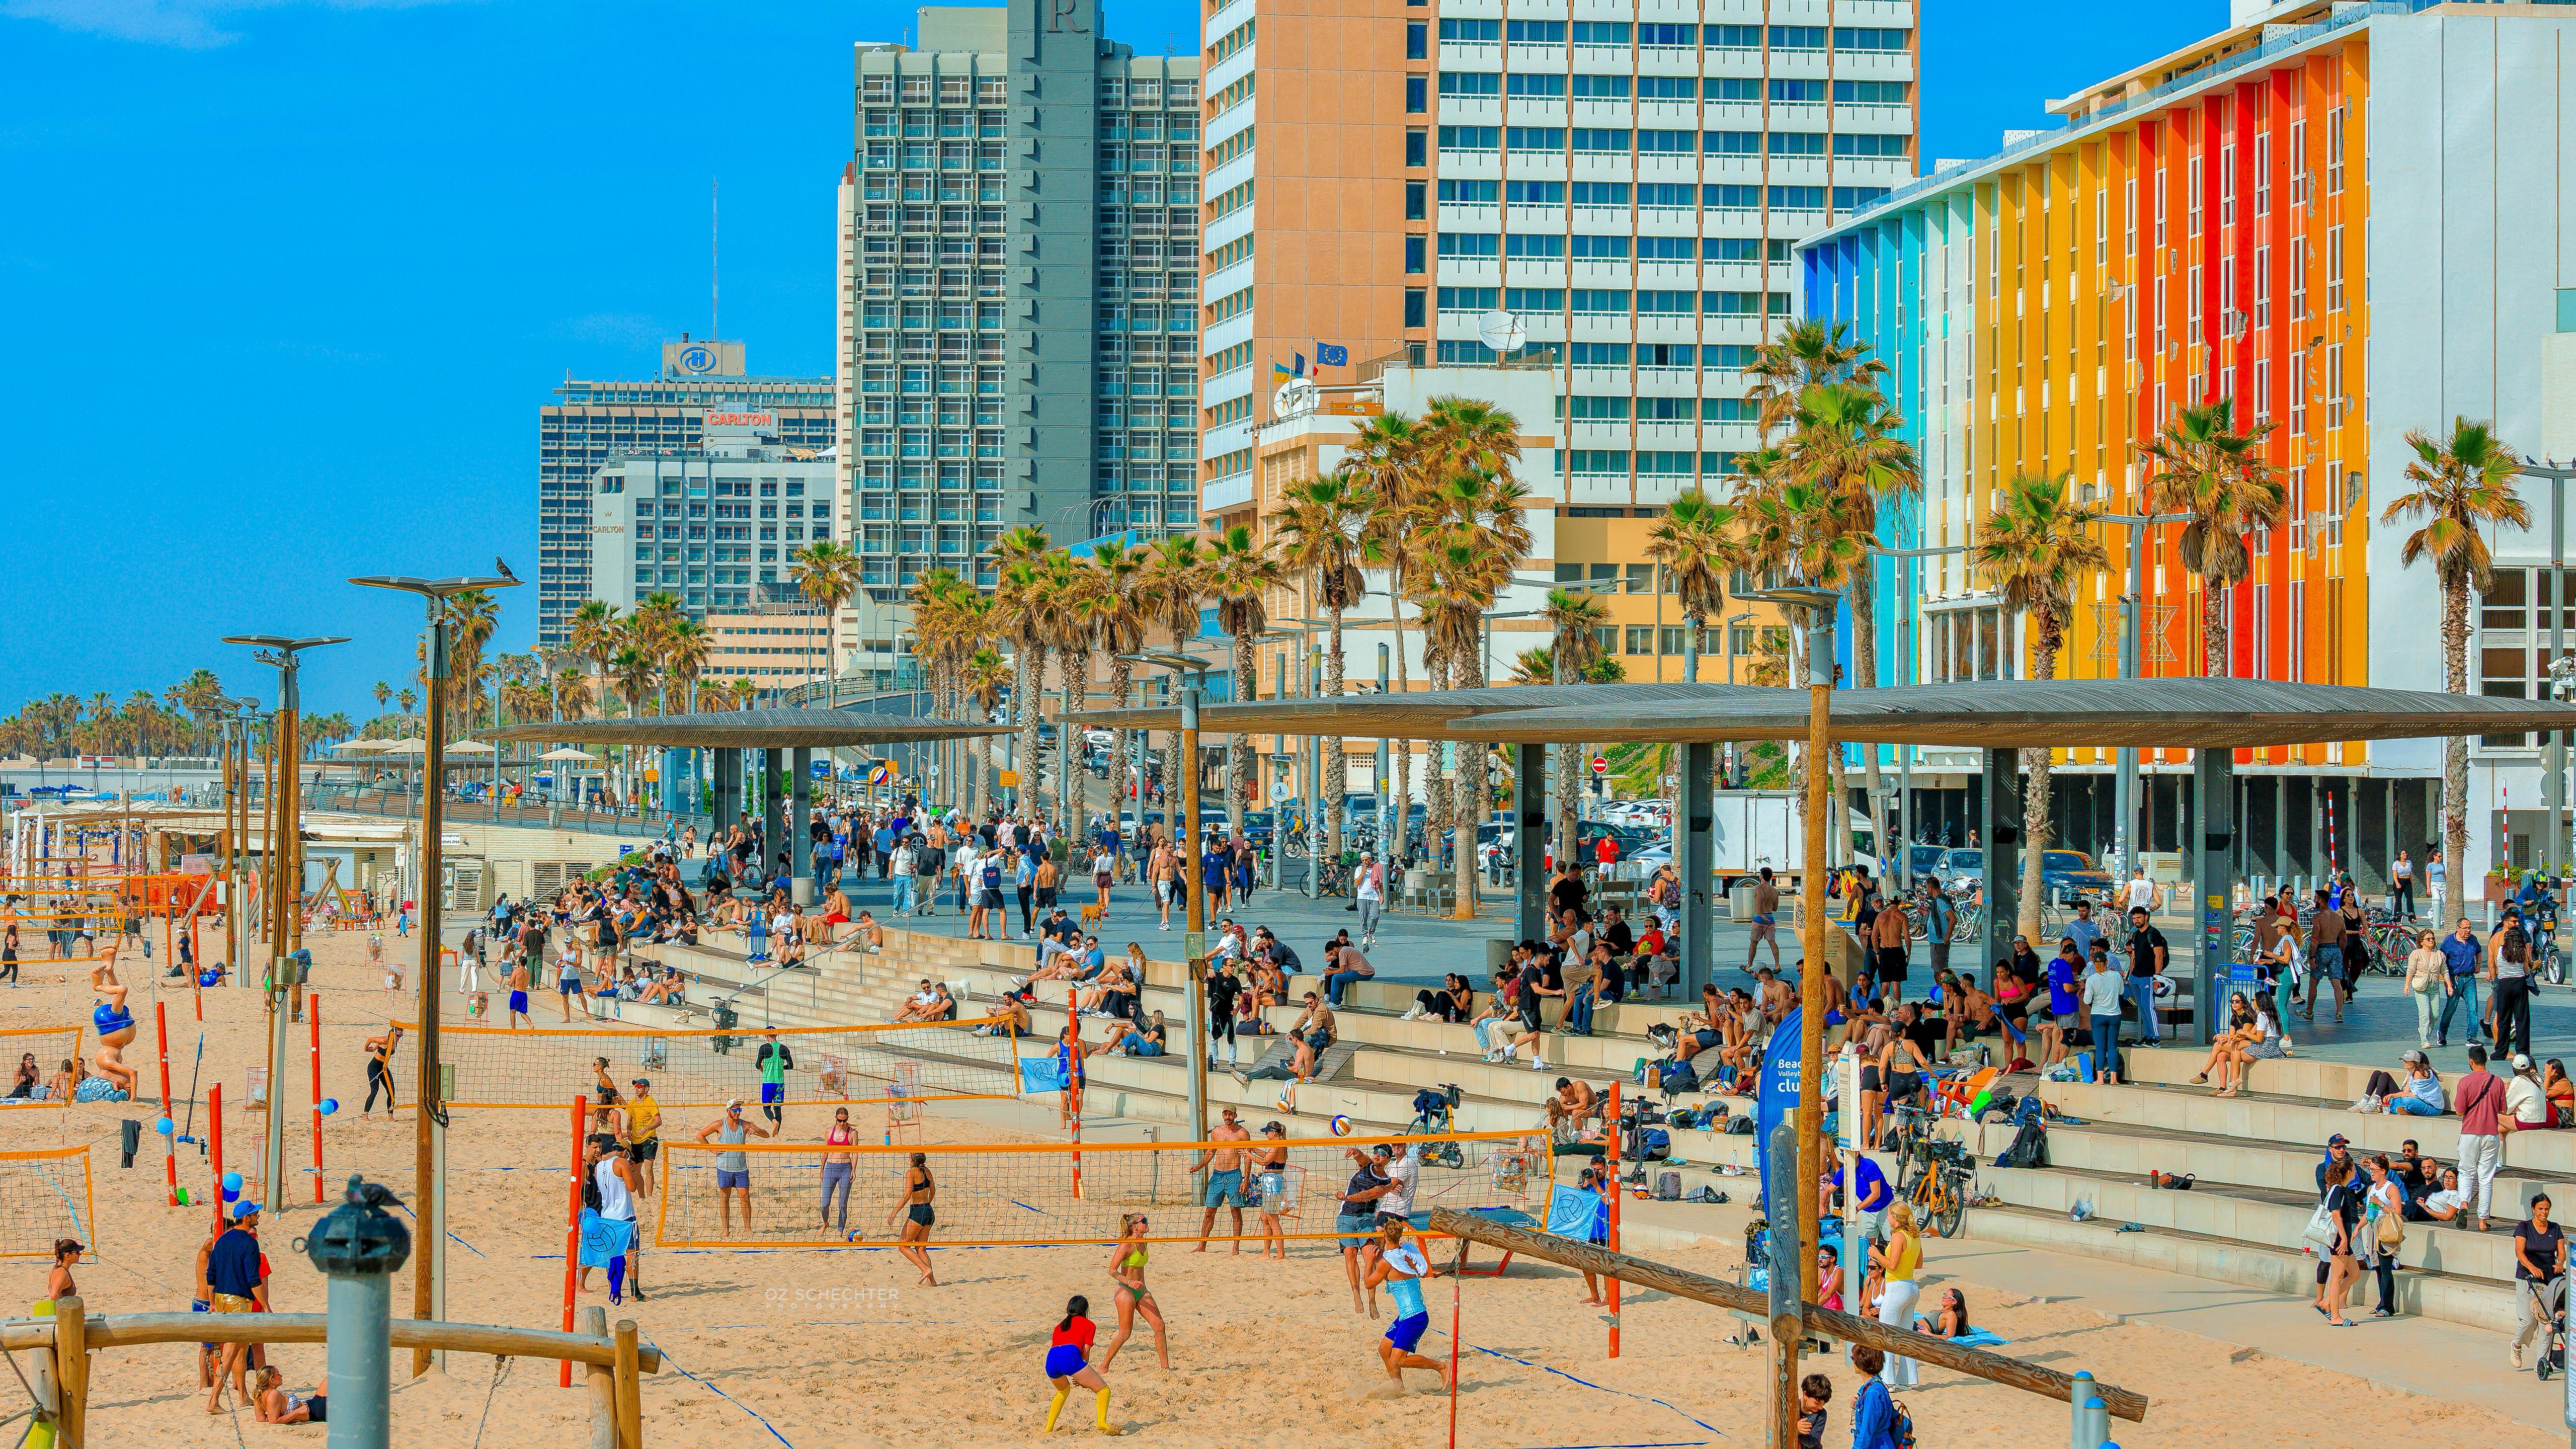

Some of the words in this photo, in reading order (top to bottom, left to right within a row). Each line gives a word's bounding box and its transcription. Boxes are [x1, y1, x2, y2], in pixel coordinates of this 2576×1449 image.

[1046, 0, 1089, 31] R
[708, 413, 771, 426] CARLTON
[1778, 1059, 1801, 1069] Beac
[1778, 1079, 1800, 1093] clu
